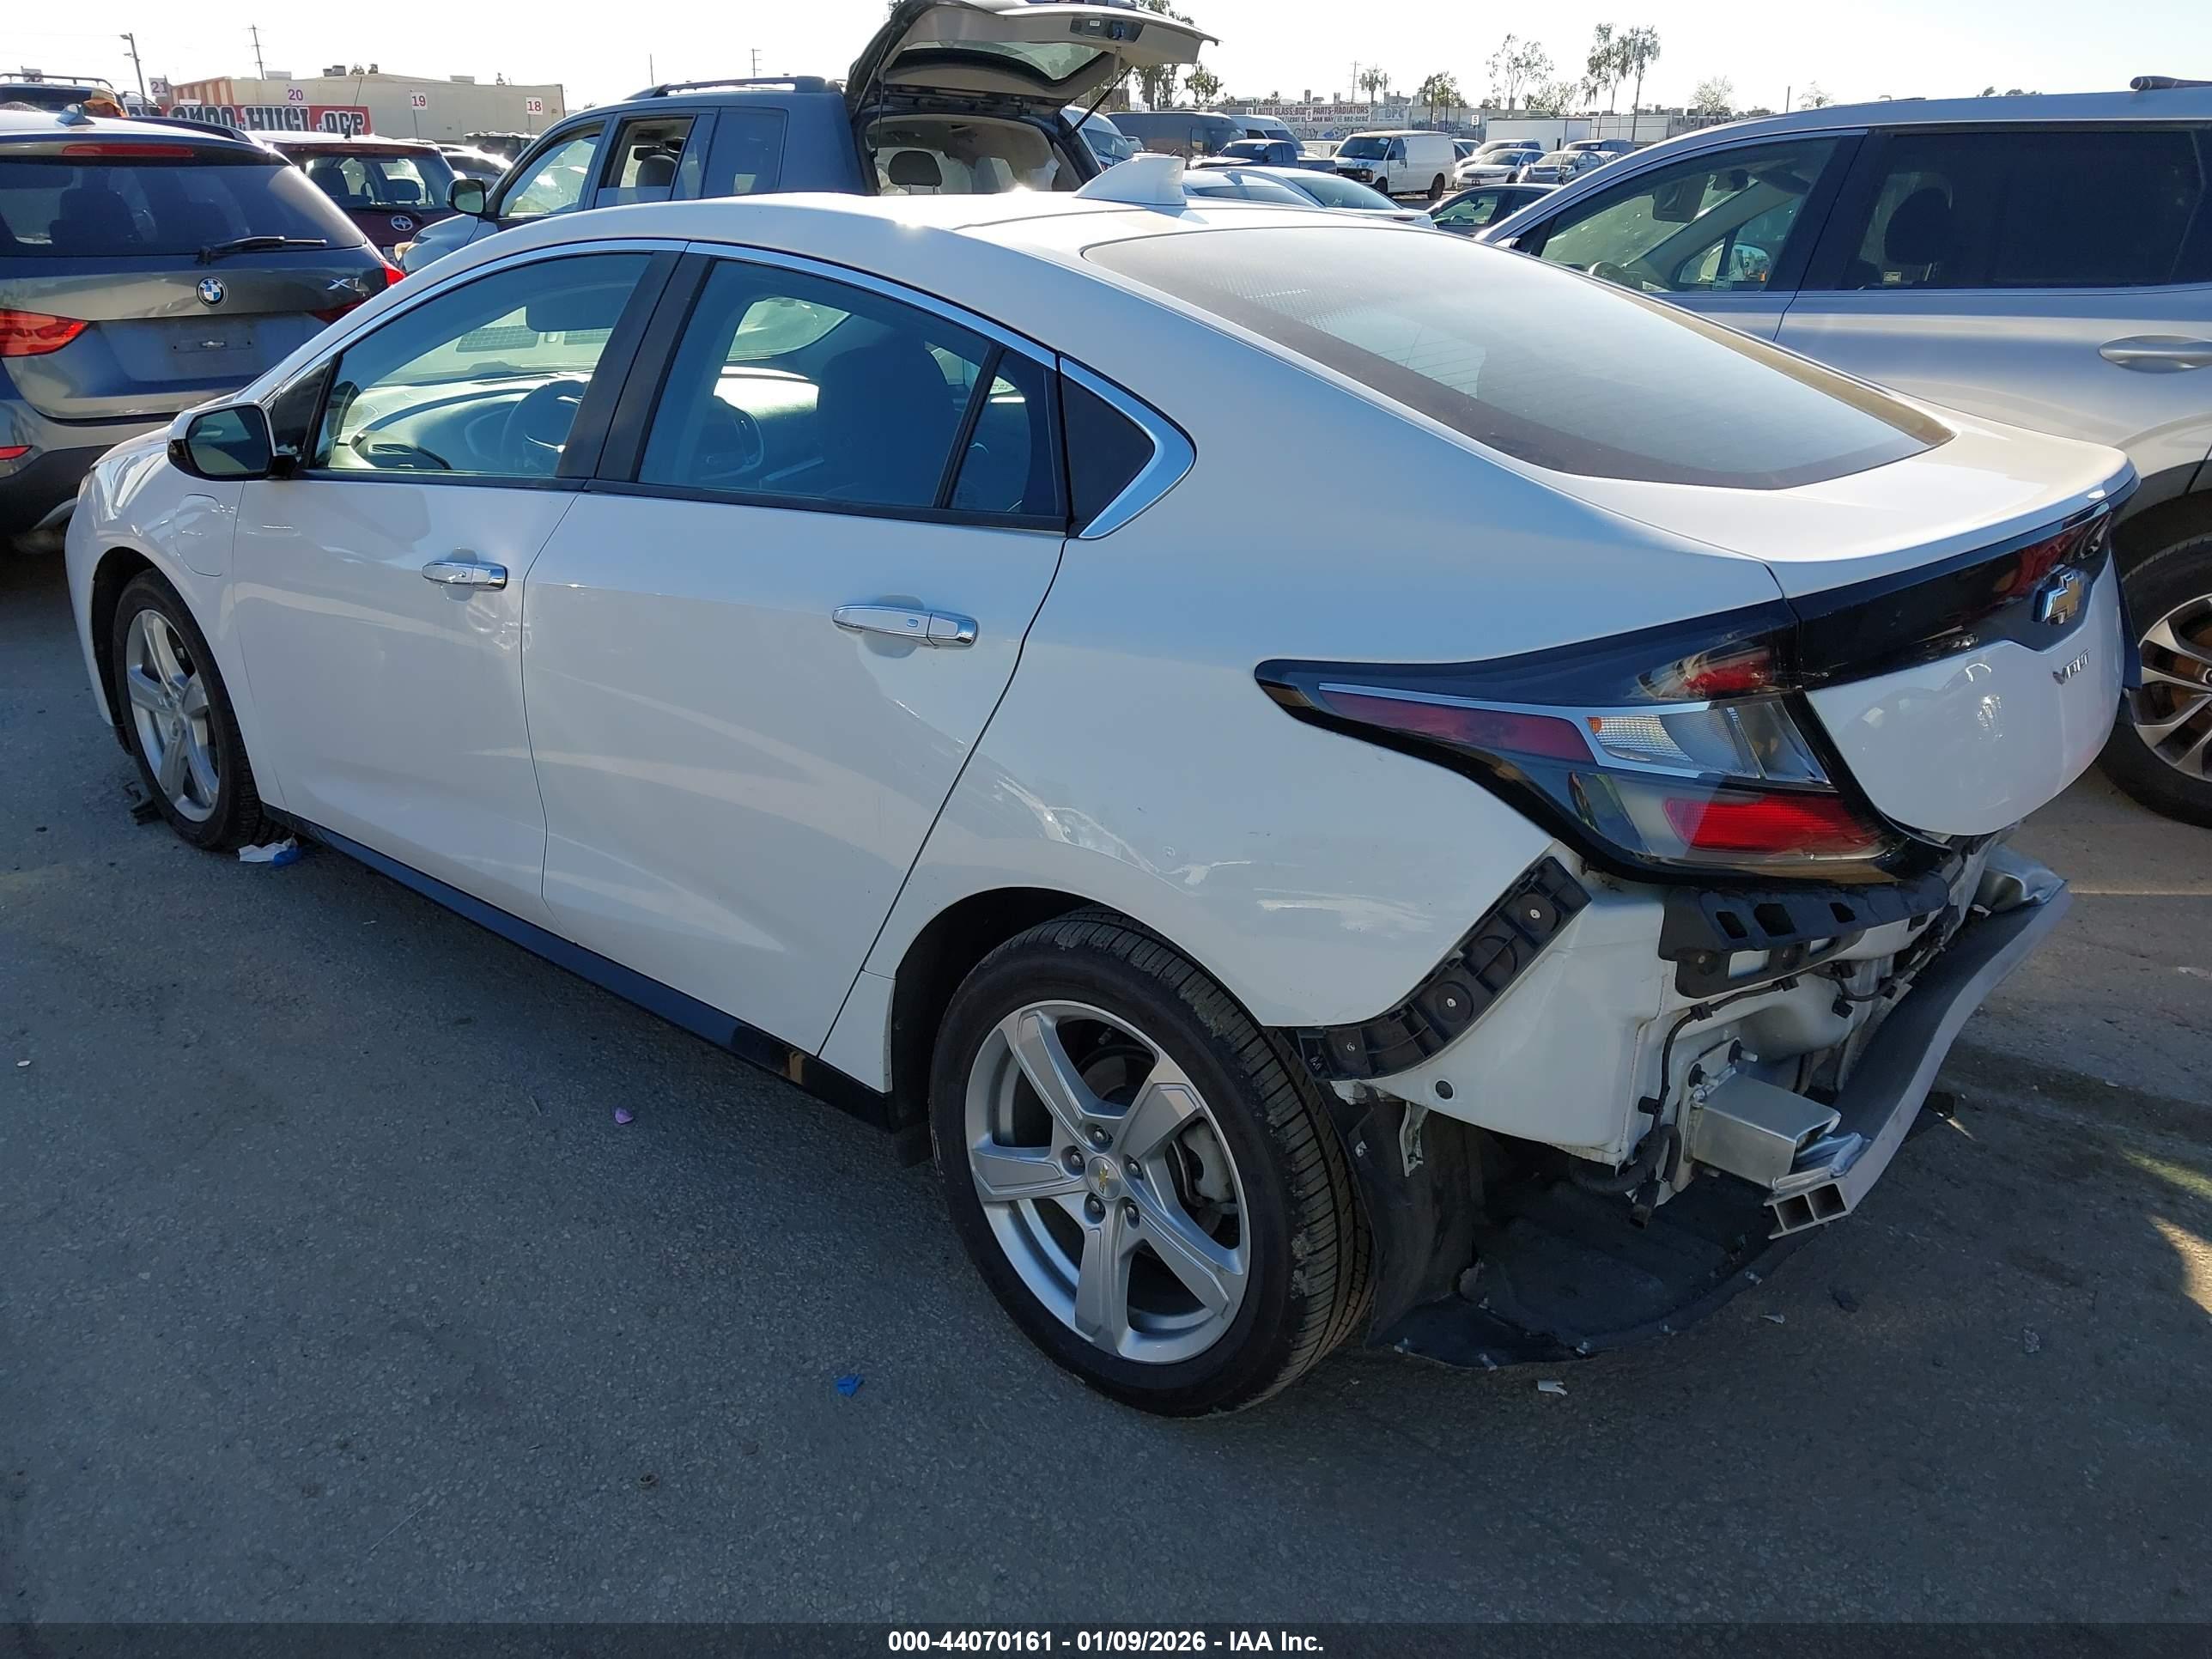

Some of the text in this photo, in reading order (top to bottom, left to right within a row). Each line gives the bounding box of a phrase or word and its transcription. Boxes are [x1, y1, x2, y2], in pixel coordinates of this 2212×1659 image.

[288, 88, 303, 101] 20
[412, 95, 426, 106] 19
[527, 100, 542, 112] 18
[1257, 106, 1273, 116] AUTO
[1307, 110, 1312, 120] 8
[326, 277, 368, 292] X1
[2053, 648, 2089, 684] VOLT
